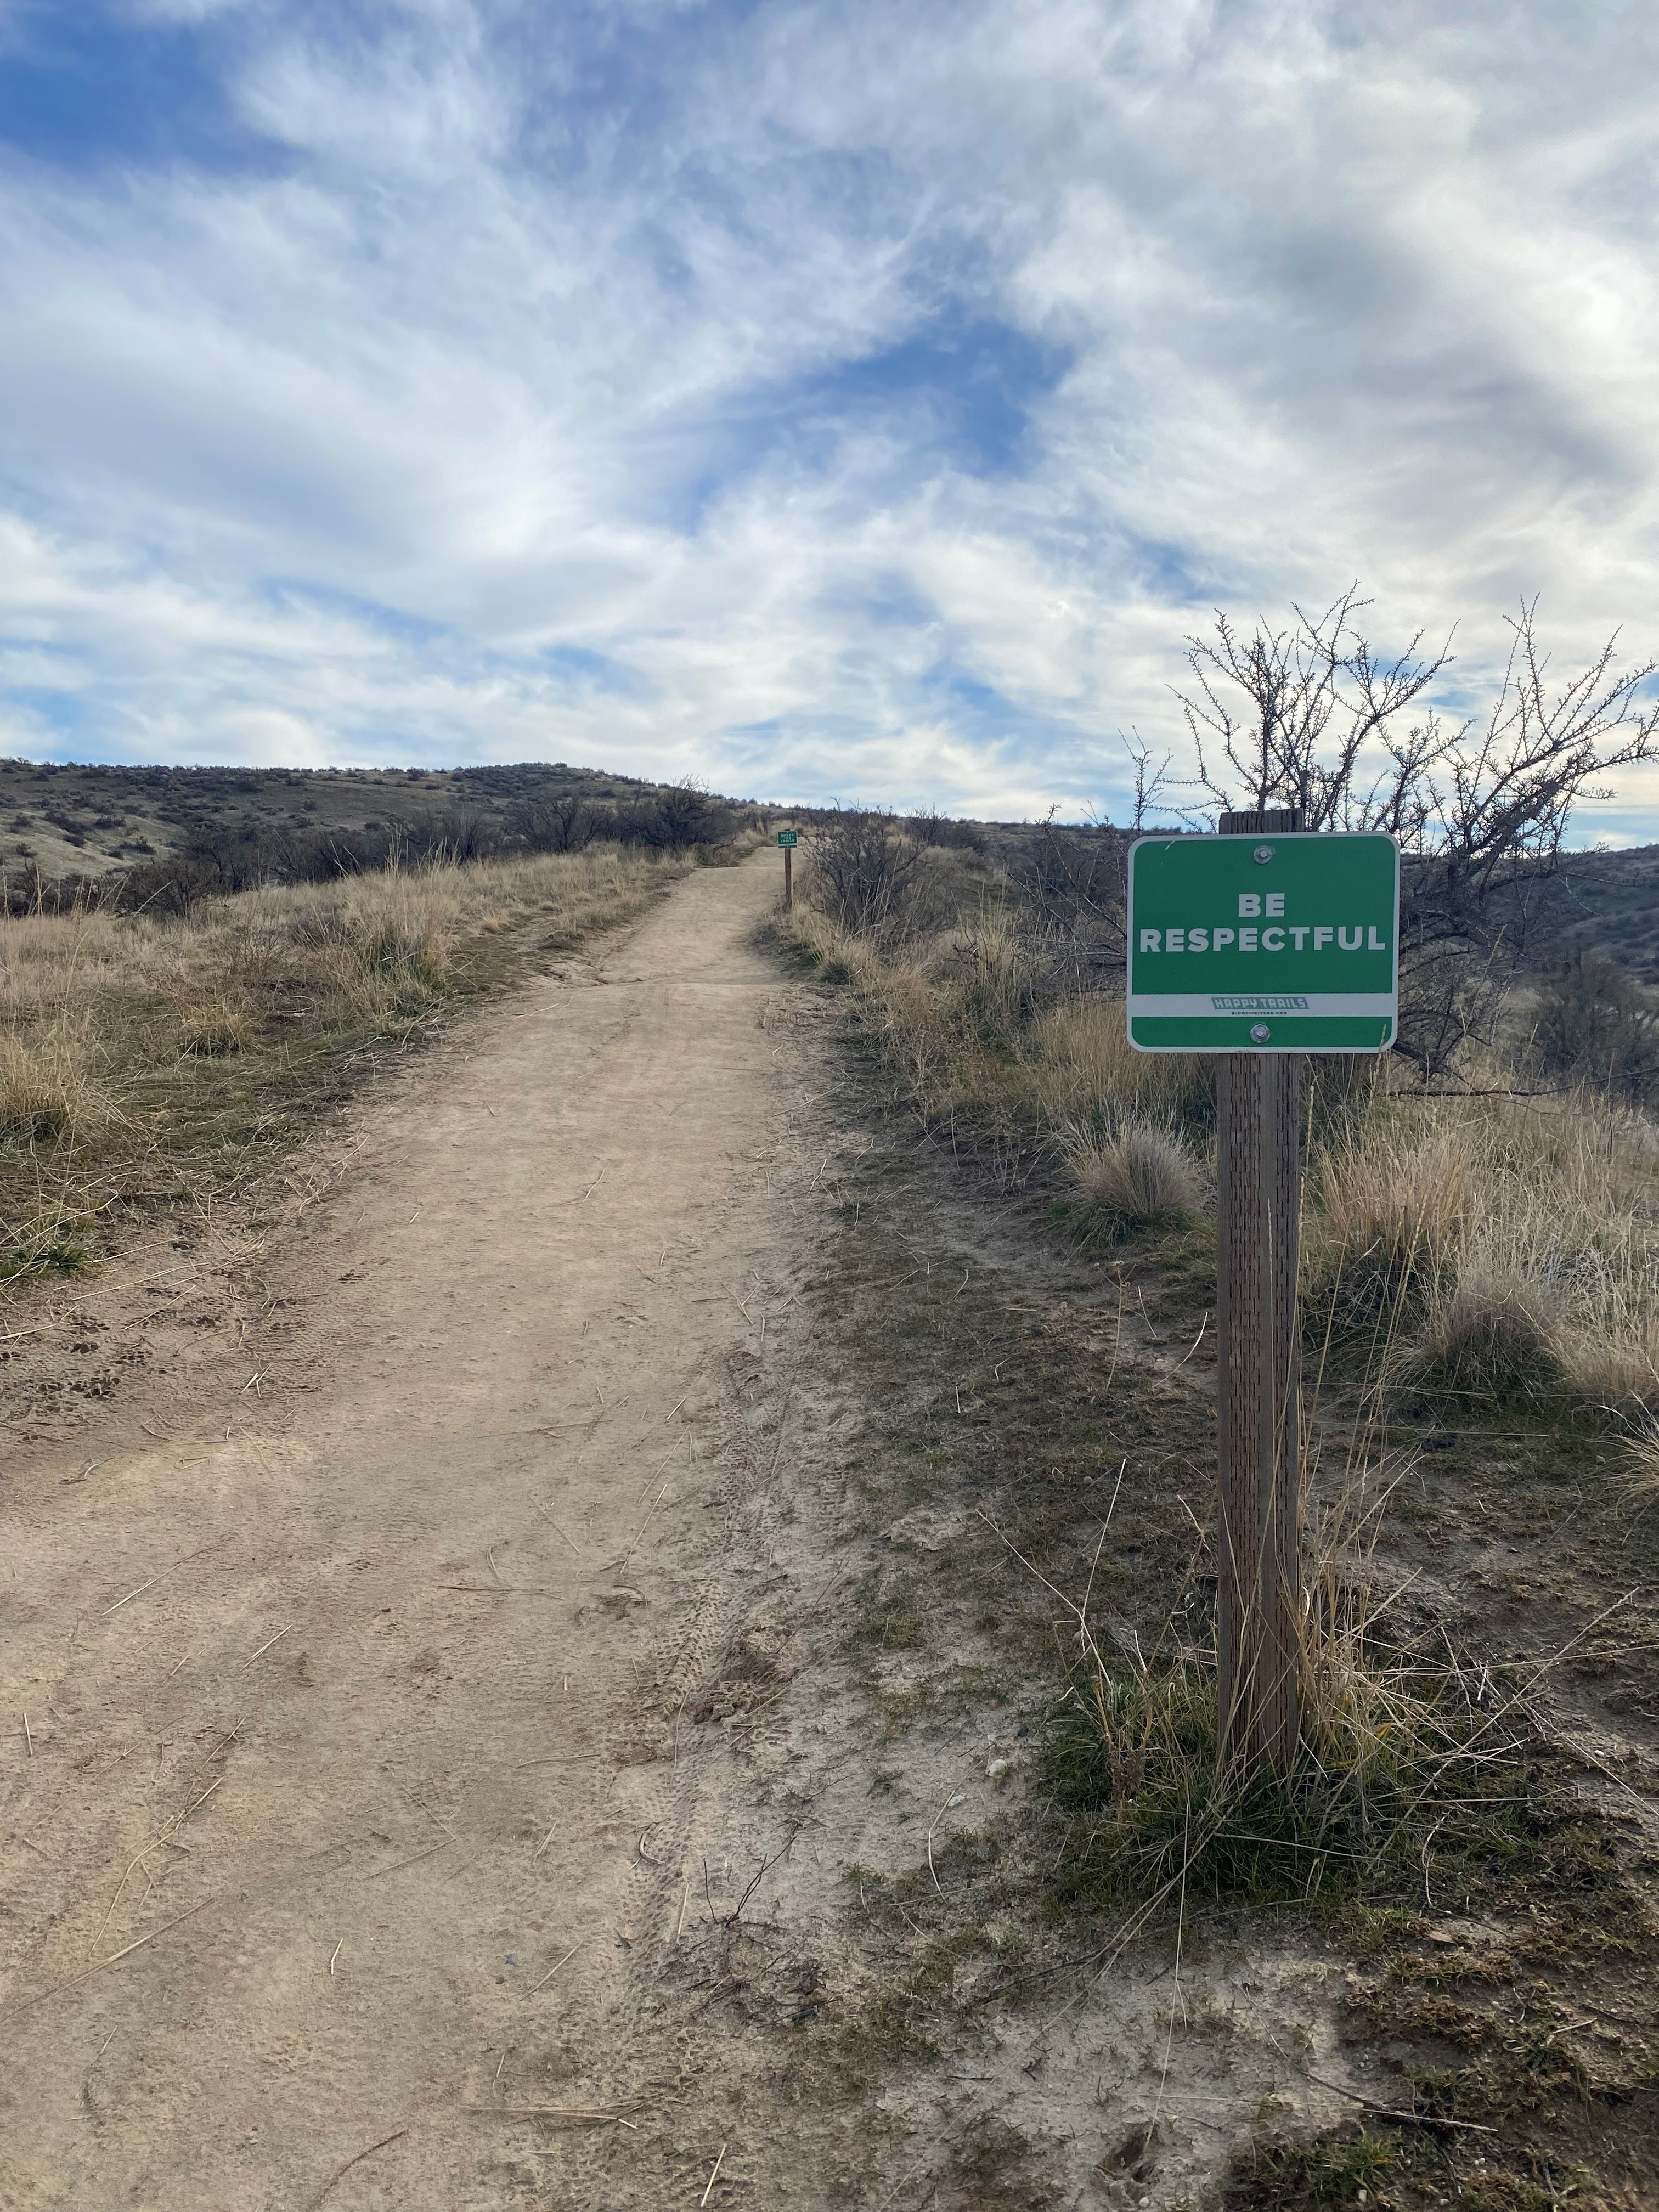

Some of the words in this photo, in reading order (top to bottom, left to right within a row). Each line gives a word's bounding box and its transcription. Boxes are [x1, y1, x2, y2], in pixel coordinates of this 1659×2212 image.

[1239, 893, 1285, 917] BE
[1140, 926, 1385, 952] RESPECTFUL
[1214, 998, 1257, 1008] HAPPY
[1260, 998, 1306, 1008] TRAILS
